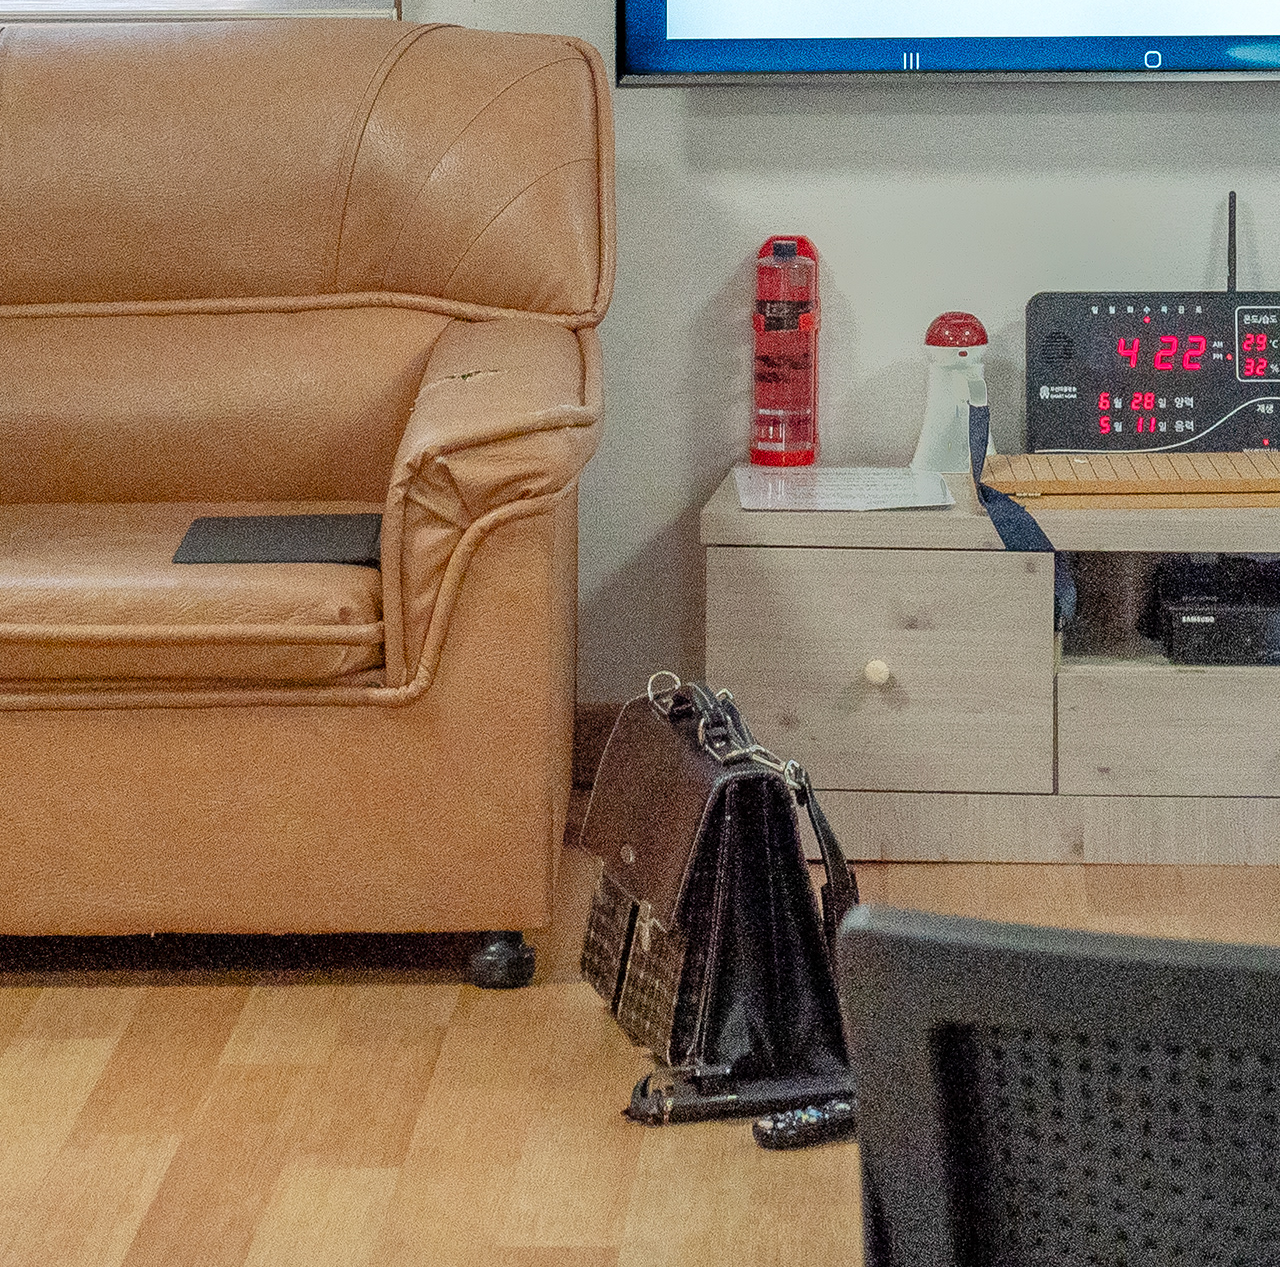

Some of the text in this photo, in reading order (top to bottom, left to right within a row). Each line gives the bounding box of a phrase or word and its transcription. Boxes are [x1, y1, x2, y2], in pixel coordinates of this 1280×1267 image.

[1242, 333, 1268, 352] 29
[1244, 357, 1268, 377] 32
[1098, 392, 1110, 411] 6
[1131, 392, 1155, 411] 28
[1099, 415, 1111, 434] 5
[1136, 417, 1157, 433] 11
